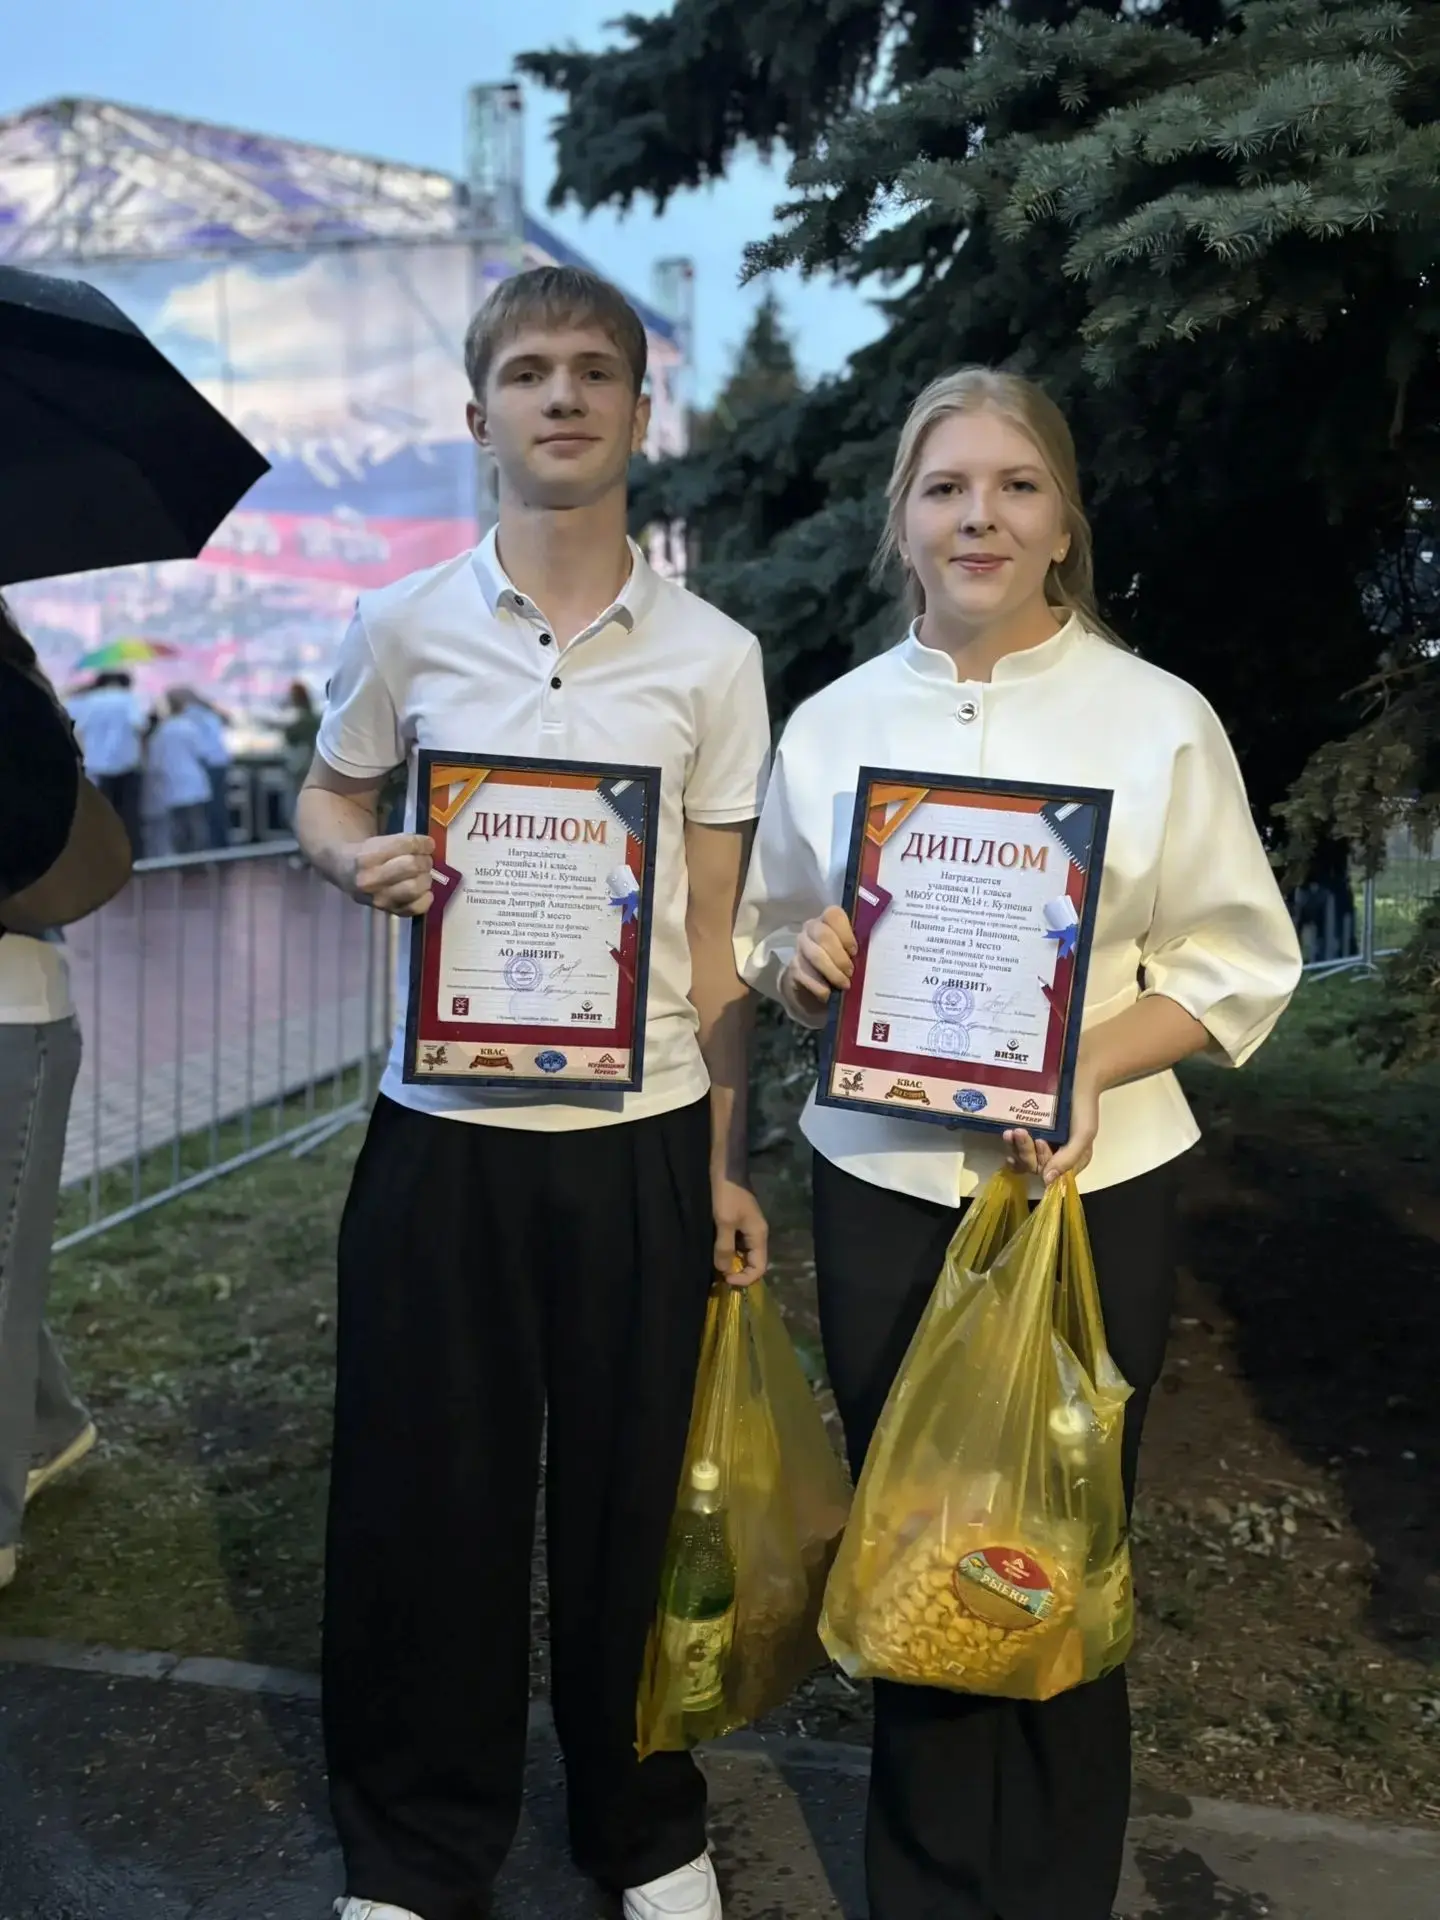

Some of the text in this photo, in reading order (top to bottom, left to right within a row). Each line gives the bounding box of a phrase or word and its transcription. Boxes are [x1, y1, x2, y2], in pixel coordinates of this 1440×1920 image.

[467, 812, 609, 844] ДИПЛОМ
[508, 848, 566, 860] Награждается
[900, 832, 1049, 873] ДИПЛОМ
[540, 862, 547, 870] 11
[475, 868, 502, 878] МБОУ
[504, 870, 528, 878] СОШ
[530, 872, 549, 880] №14
[940, 871, 1002, 886] Награждается
[972, 886, 980, 894] 11
[983, 889, 1012, 898] класса
[466, 896, 506, 905] Николаев
[508, 898, 546, 908] Дмитрий
[904, 890, 934, 900] МБОУ
[935, 893, 960, 904] СОШ
[962, 896, 982, 906] №14
[992, 900, 1032, 912] Кузнецка
[948, 924, 974, 936] Елена
[976, 928, 1020, 942] Ивановна,
[968, 939, 974, 948] 3
[976, 943, 1002, 951] место
[498, 948, 564, 960] АО «ВИЗИТ»
[922, 976, 992, 992] АО «ВИЗИТ»
[570, 1012, 602, 1020] ВИЗИТ
[480, 1048, 505, 1056] КВАС
[994, 1050, 1029, 1062] ВИЗИТ
[897, 1078, 922, 1088] КВАС
